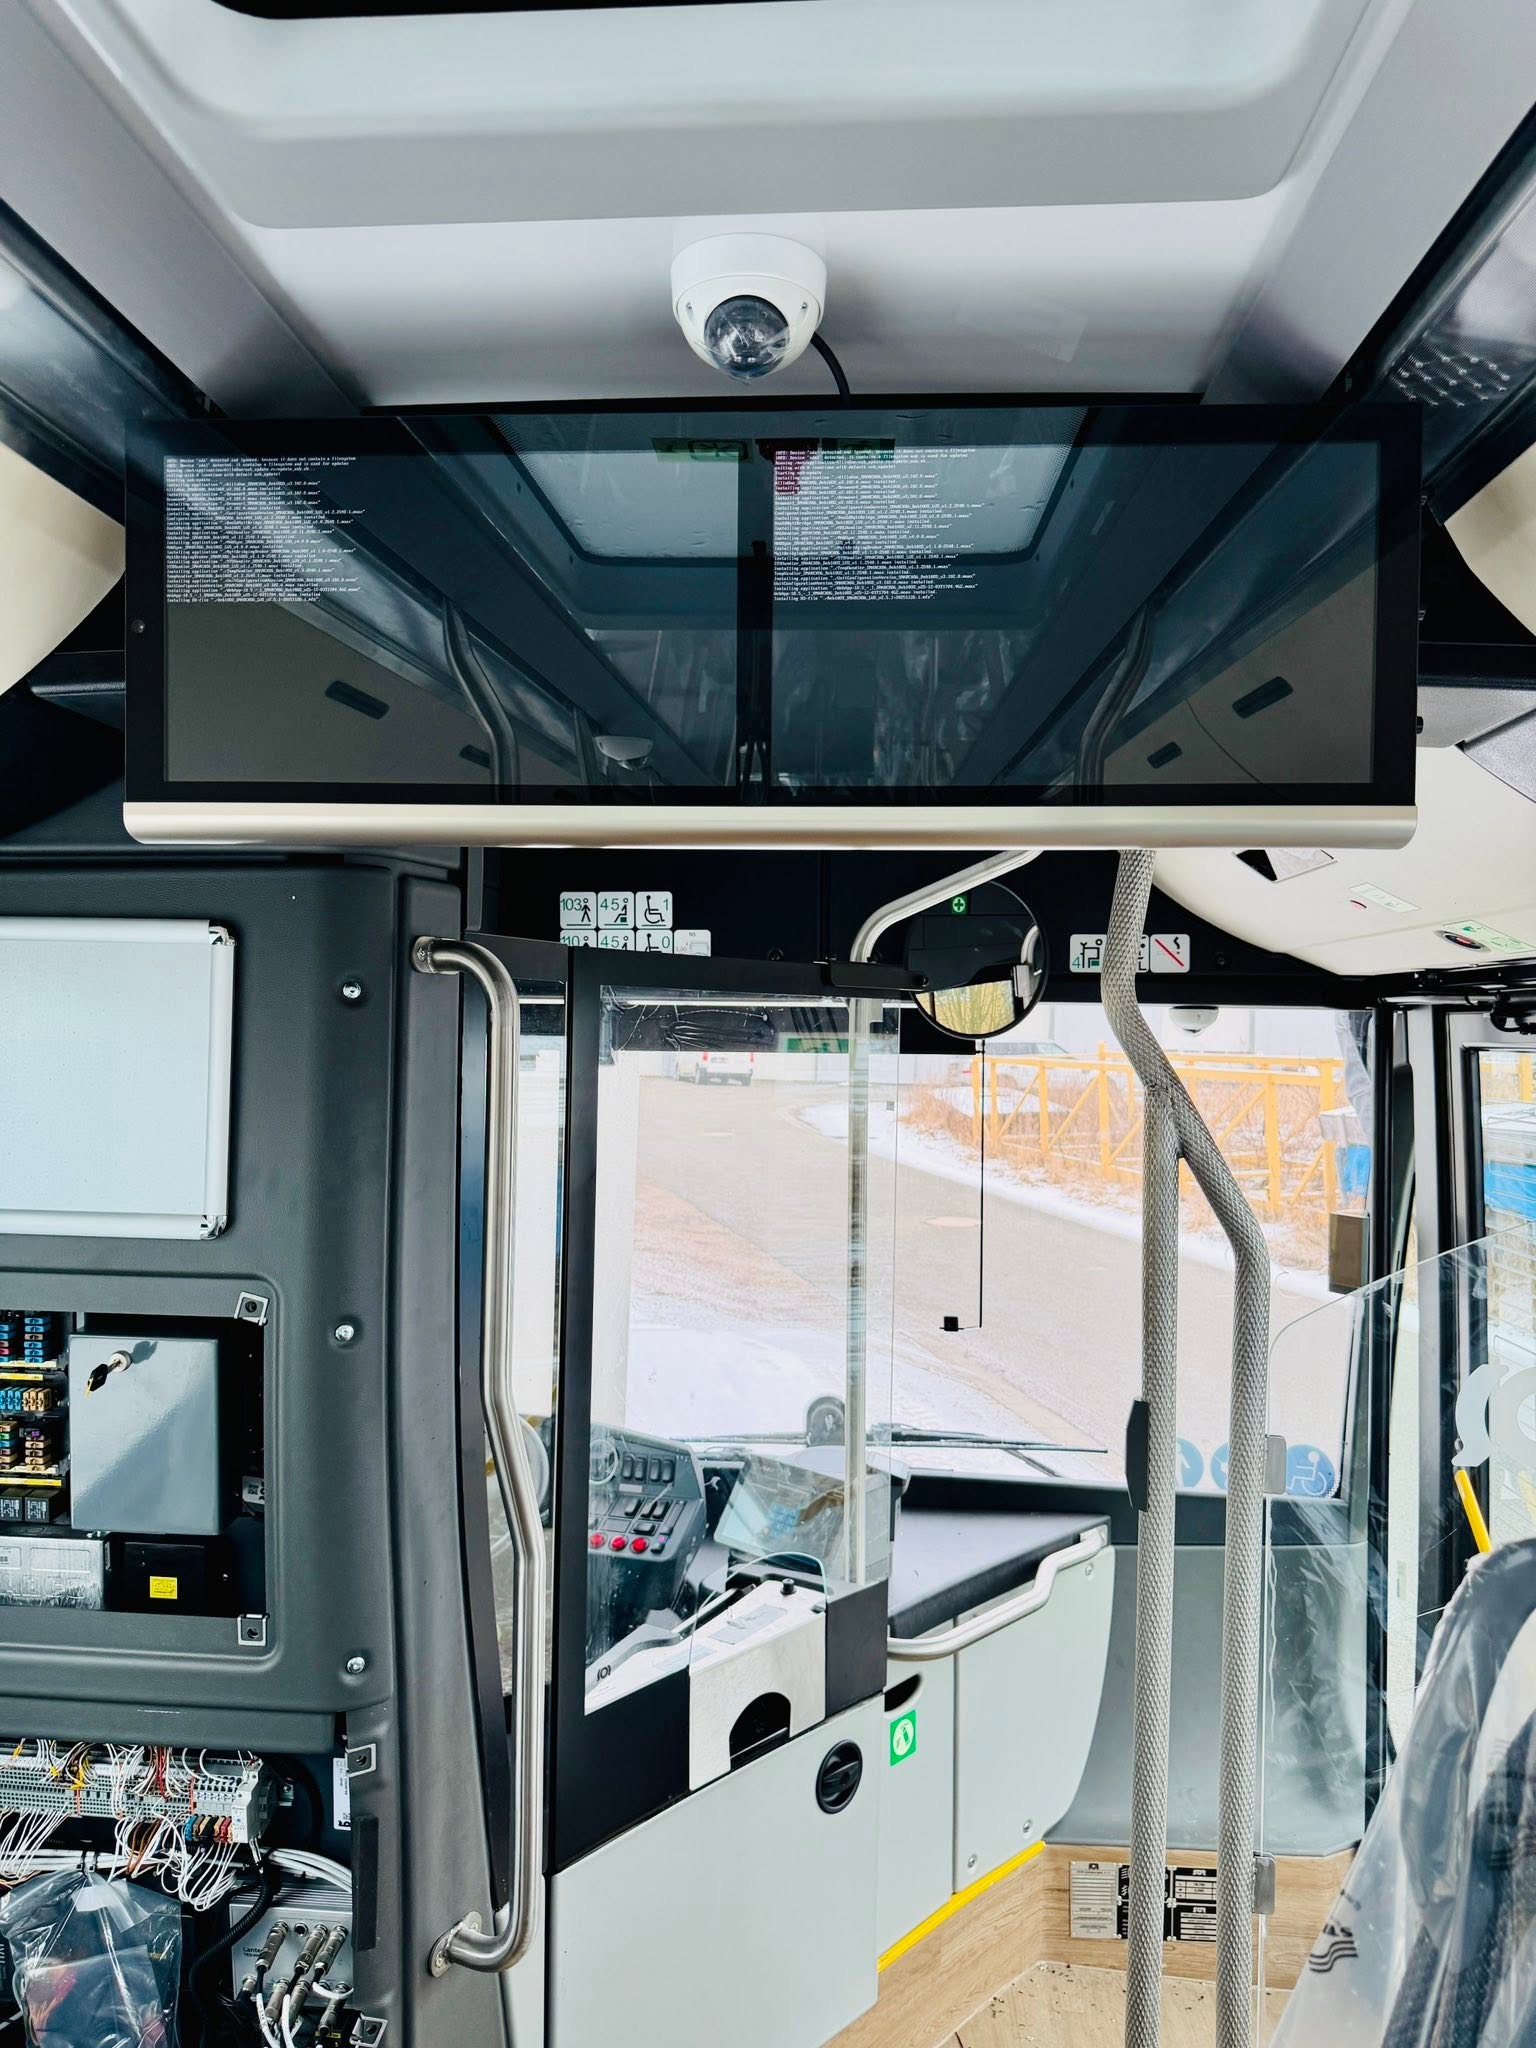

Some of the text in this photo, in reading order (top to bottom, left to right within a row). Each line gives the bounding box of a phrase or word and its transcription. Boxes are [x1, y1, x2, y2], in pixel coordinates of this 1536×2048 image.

[560, 898, 582, 911] 103
[663, 898, 670, 911] 1
[560, 936, 580, 946] 110
[1072, 956, 1080, 968] 4
